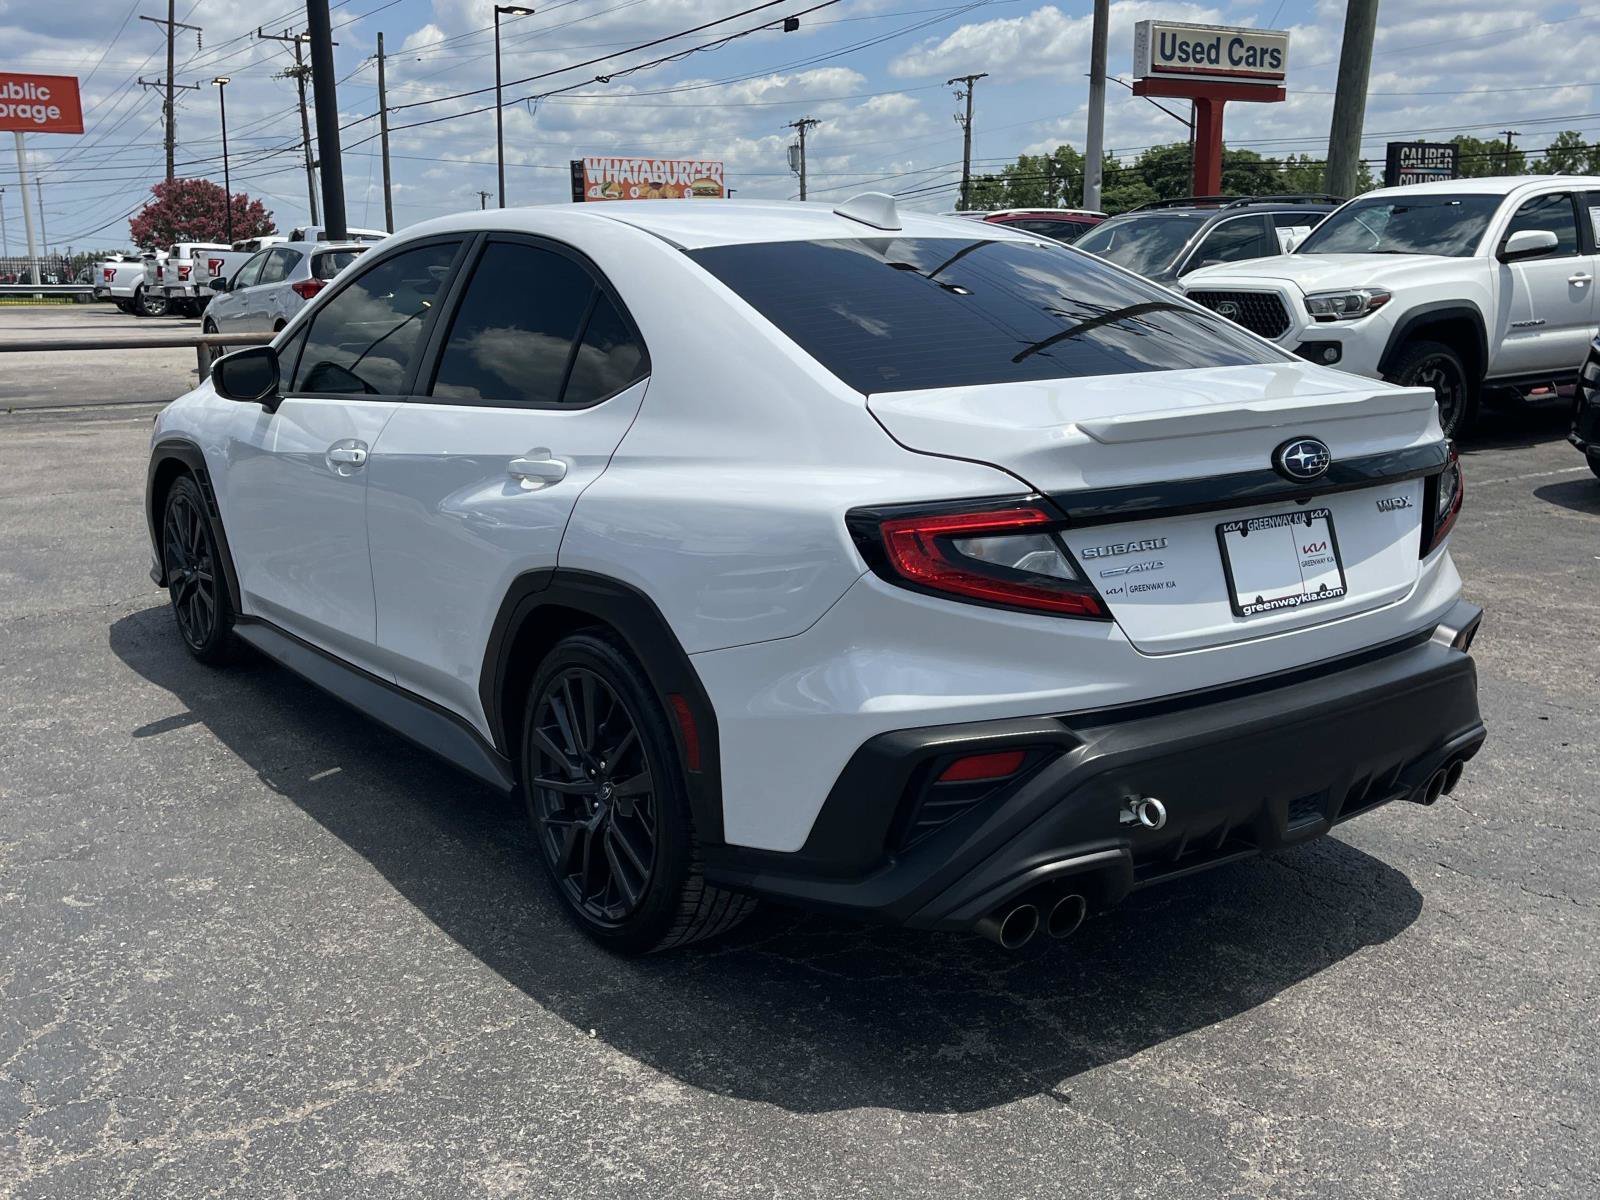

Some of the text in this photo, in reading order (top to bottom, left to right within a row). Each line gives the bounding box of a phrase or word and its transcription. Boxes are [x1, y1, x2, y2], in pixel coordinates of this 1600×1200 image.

[1160, 32, 1282, 69] Used Cars
[1400, 146, 1453, 169] CALIBER
[584, 159, 723, 186] WHATABURGER
[1376, 496, 1413, 513] WRX
[1223, 509, 1329, 532] KIA GREENWAY KIA KIA
[1082, 538, 1169, 560] SUBARU
[1303, 541, 1327, 554] KIA
[1301, 556, 1335, 568] GREENWAY KIA
[1105, 581, 1177, 595] KIA GREENWAY KIA
[1242, 586, 1344, 616] greenwaykia.com
